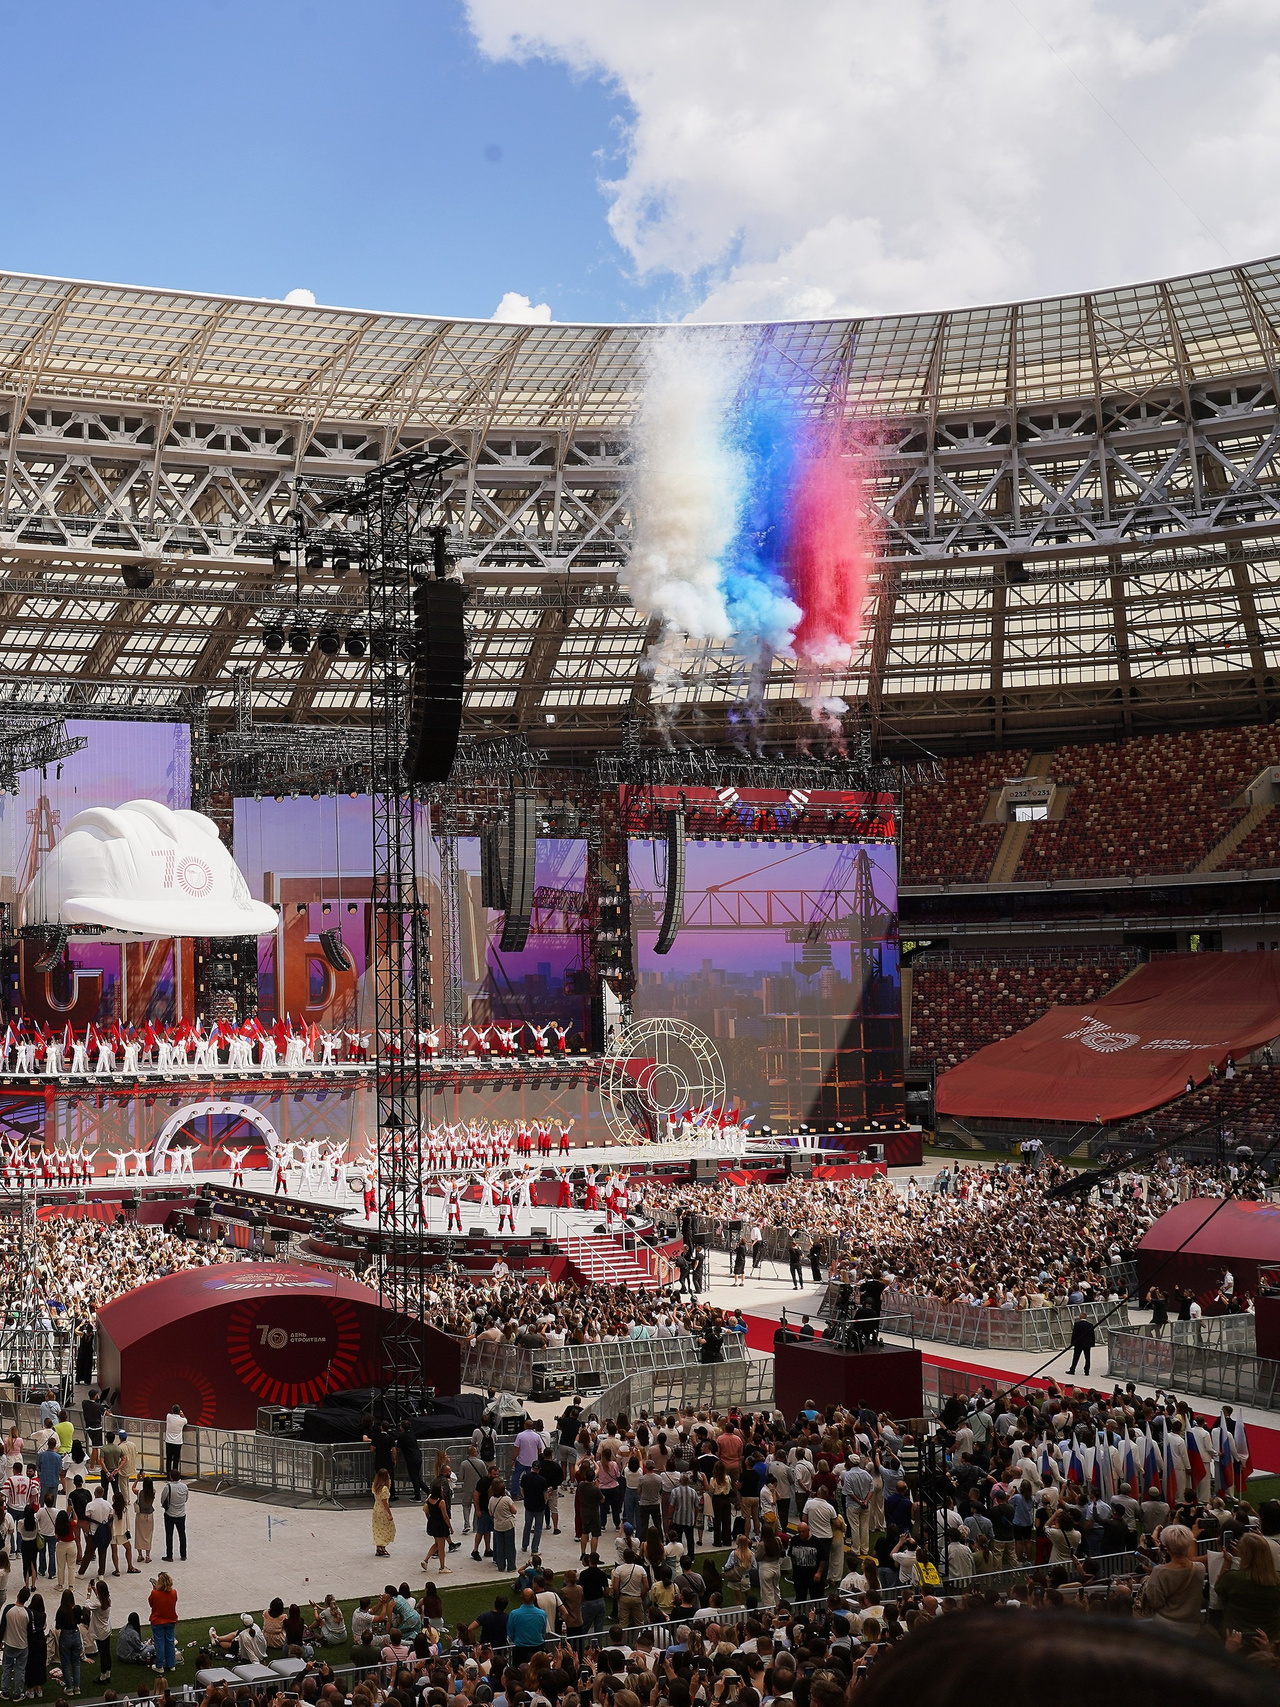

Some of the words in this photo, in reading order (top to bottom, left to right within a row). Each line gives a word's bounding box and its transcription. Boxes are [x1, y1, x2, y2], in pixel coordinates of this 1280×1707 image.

[150, 849, 214, 898] 70
[256, 1324, 288, 1349] 70
[16, 1483, 28, 1495] 12
